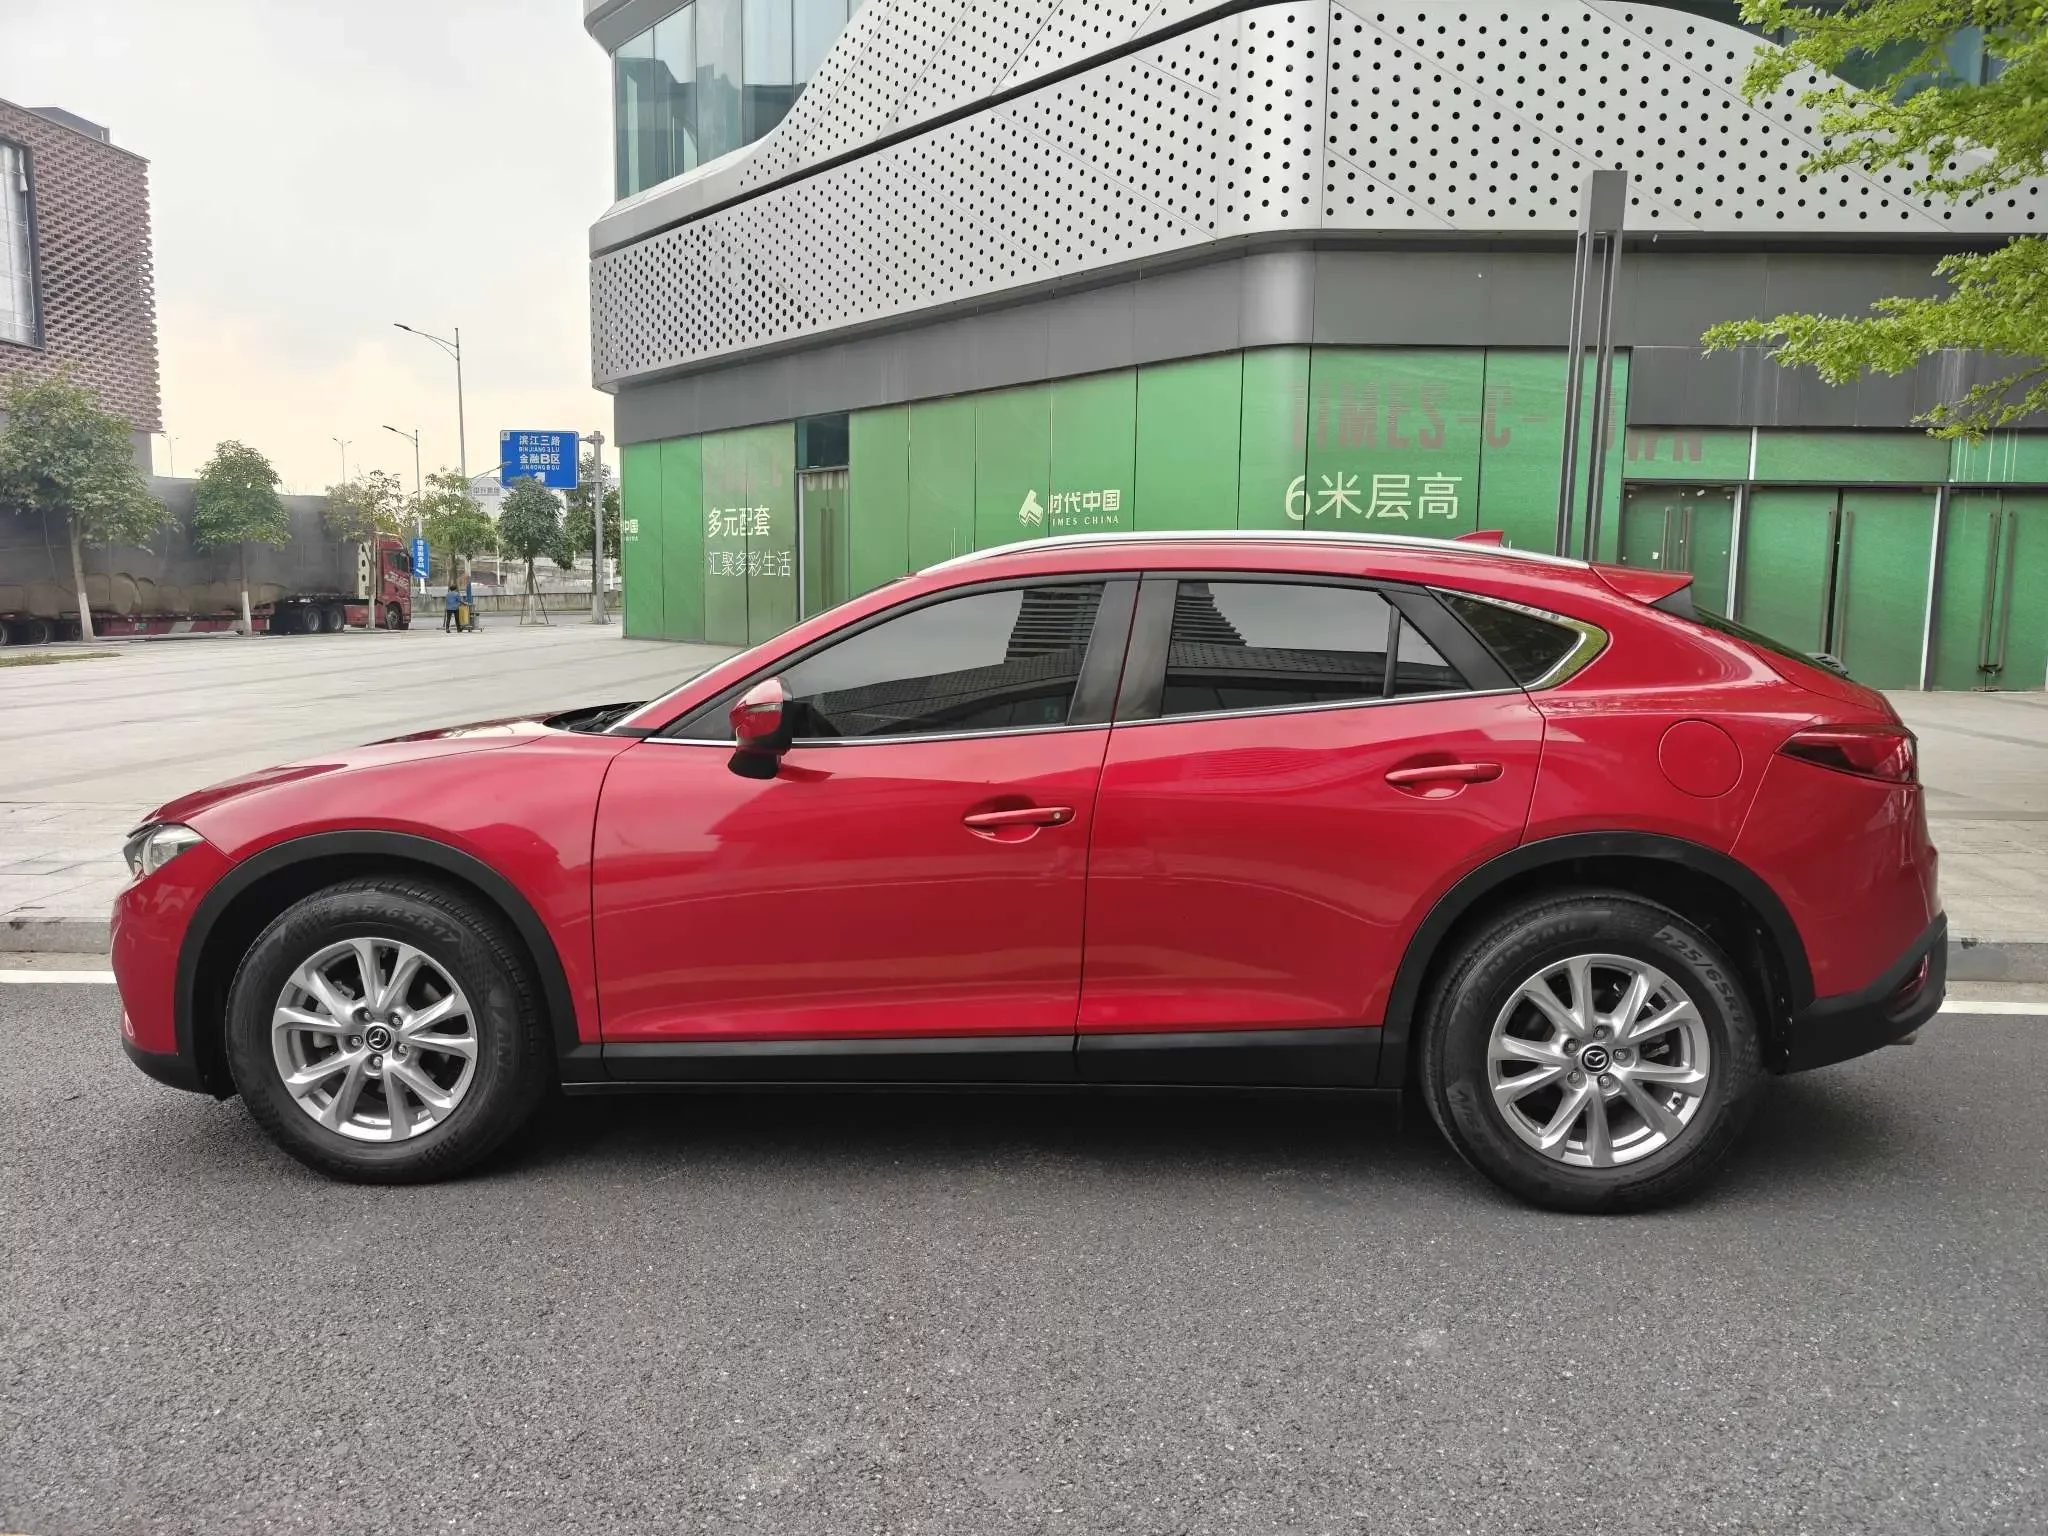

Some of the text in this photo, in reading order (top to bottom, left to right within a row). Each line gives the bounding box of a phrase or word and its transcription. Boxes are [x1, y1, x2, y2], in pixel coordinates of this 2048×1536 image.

[519, 435, 561, 446] 滨江三路
[519, 453, 561, 464] 金融B区
[1047, 489, 1121, 514] 时代中国
[1285, 471, 1463, 521] 6米层高
[708, 504, 771, 538] 多元配套
[1084, 514, 1119, 526] CHINA
[709, 548, 792, 577] 汇聚多彩生活
